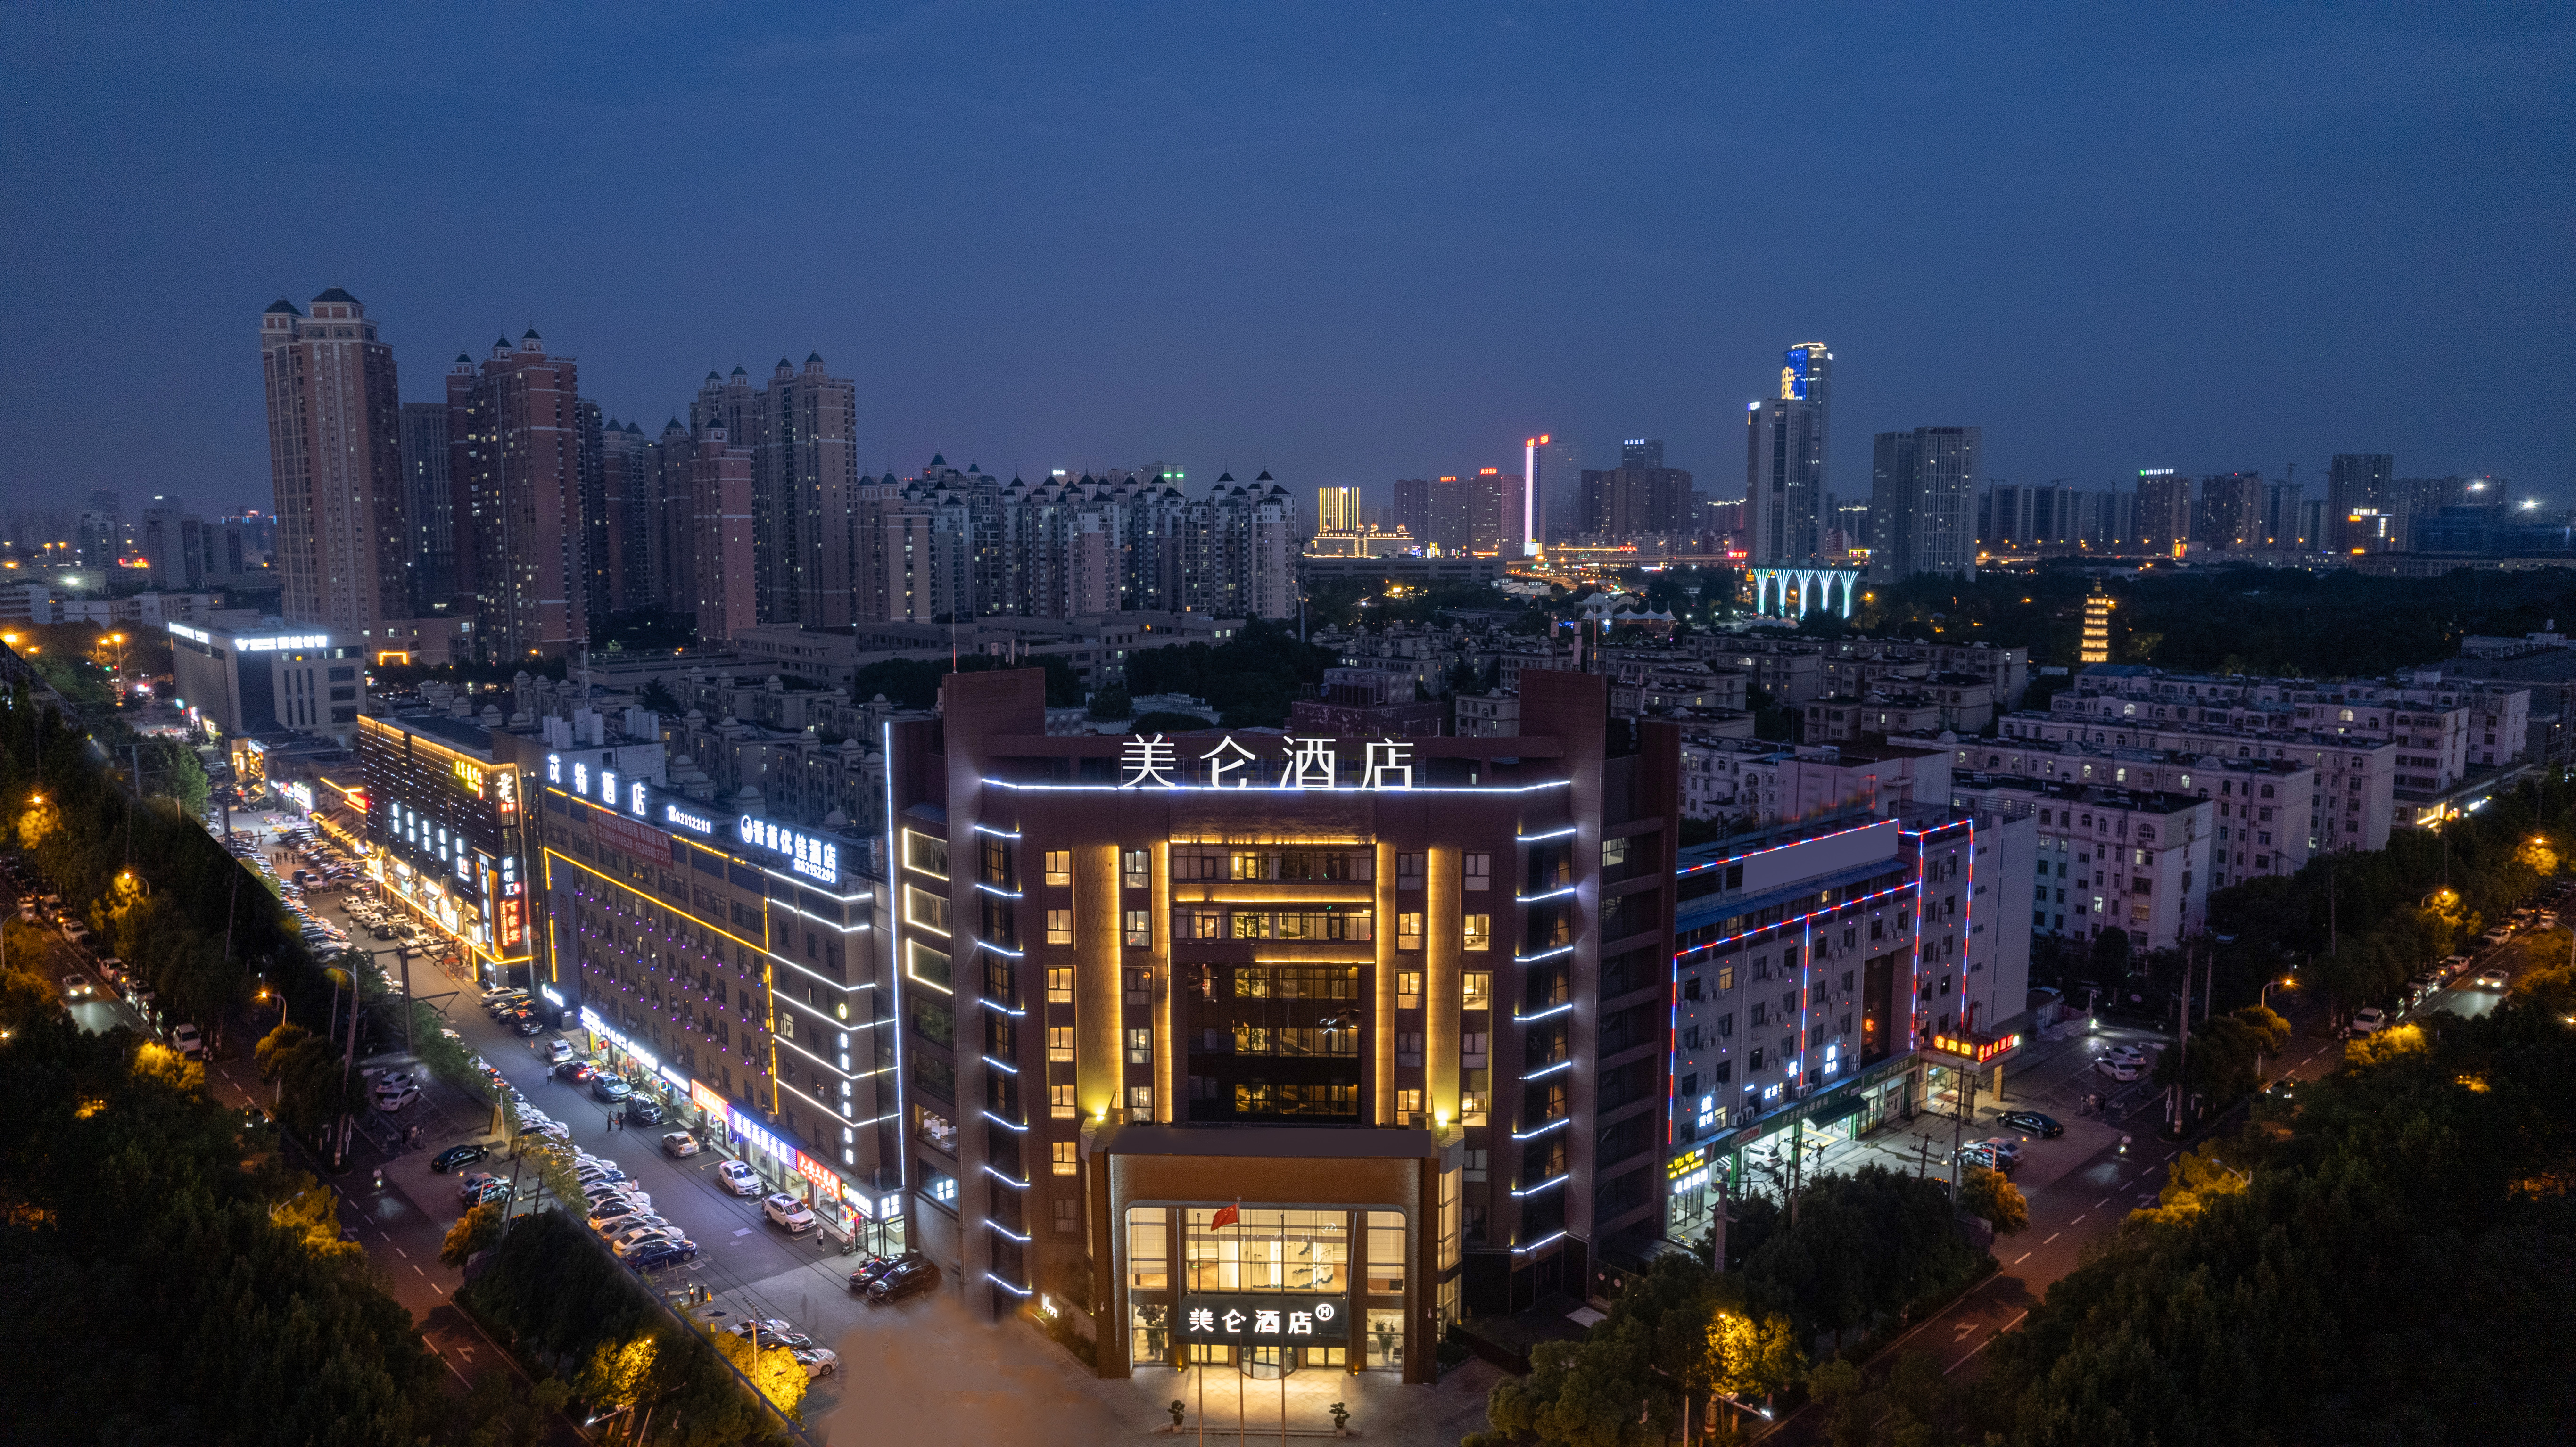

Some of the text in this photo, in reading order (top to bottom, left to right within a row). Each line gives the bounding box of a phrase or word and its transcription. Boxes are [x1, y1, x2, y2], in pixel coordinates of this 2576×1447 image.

[1121, 733, 1414, 791] 美仑酒店
[1189, 1308, 1313, 1334] 美仑酒店
